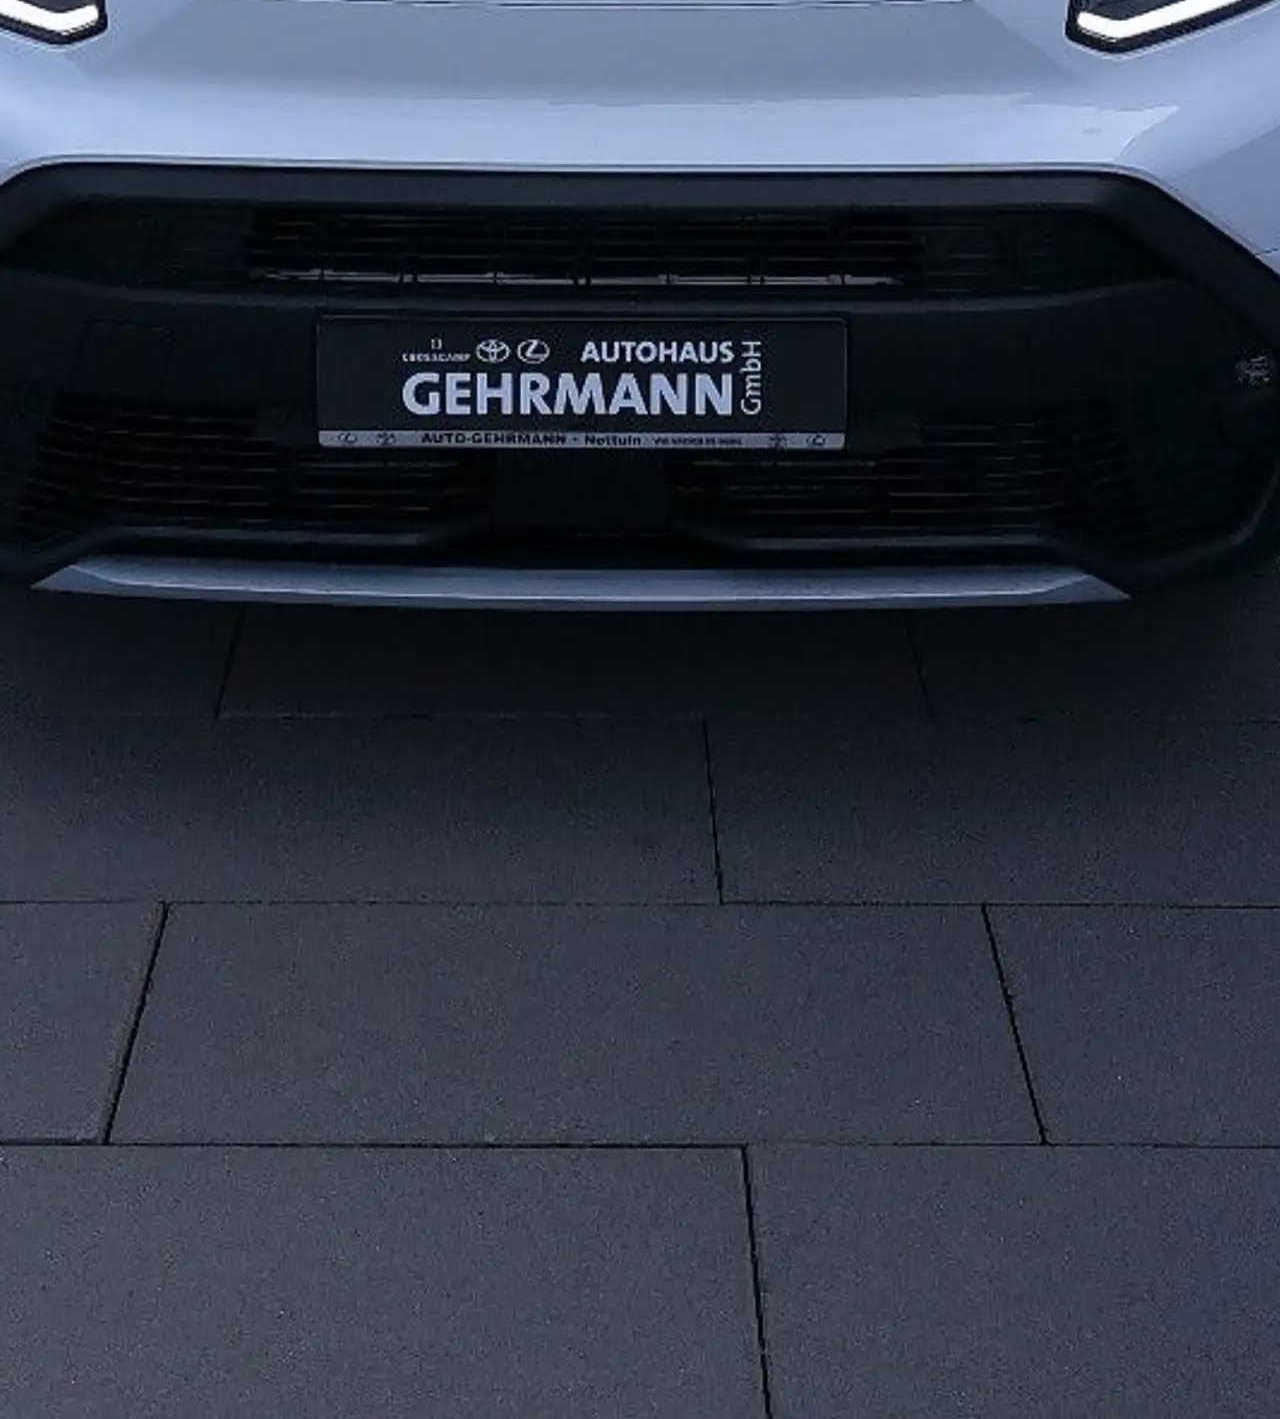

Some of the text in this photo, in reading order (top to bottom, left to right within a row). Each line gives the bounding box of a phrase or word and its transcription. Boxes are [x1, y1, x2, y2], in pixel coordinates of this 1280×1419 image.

[580, 341, 735, 363] AUTOHAUS
[402, 372, 733, 415] GEHRMANN
[740, 341, 762, 415] GmbH
